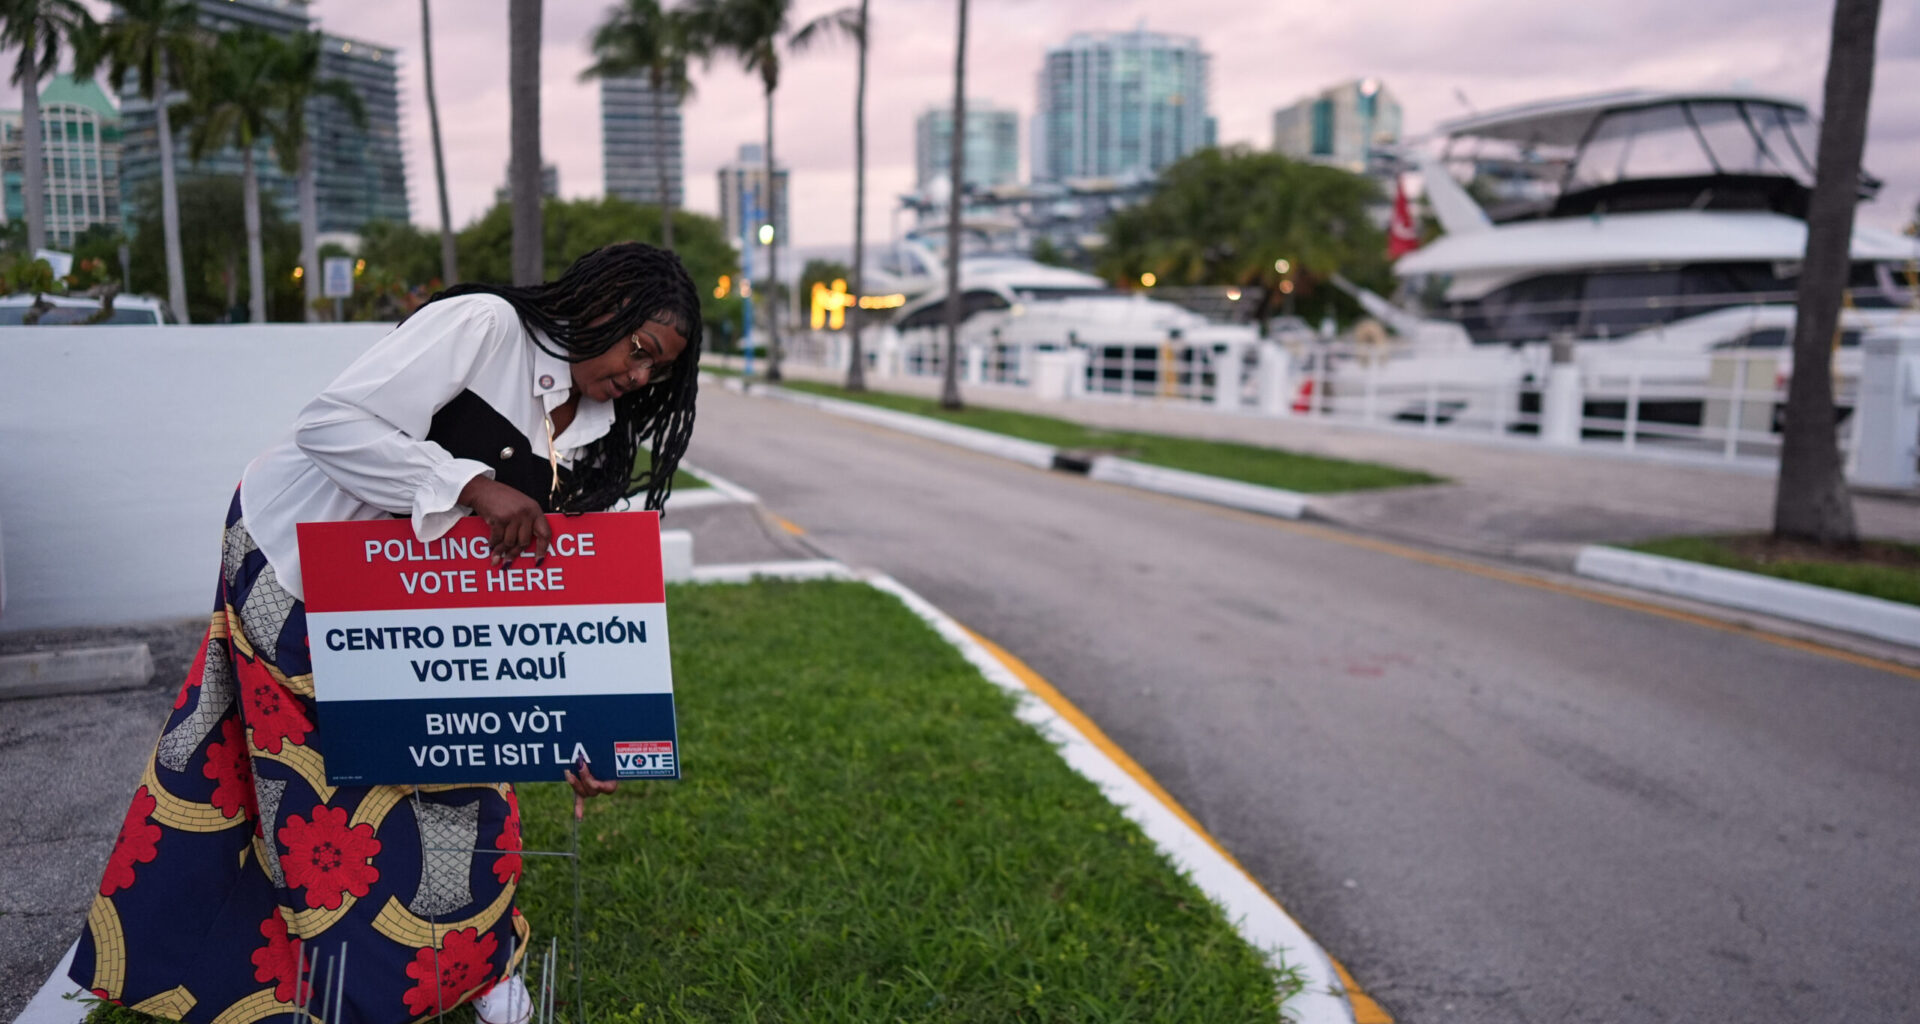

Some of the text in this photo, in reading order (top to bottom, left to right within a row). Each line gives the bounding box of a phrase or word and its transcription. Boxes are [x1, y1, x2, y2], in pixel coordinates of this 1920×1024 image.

[364, 536, 490, 563] POLLING
[400, 567, 565, 595] VOTE HERE
[325, 616, 648, 652] CENTRO DE VOTACIÓN
[410, 651, 566, 682] VOTE AQUÍ
[425, 705, 567, 736] BIWO VÒT
[408, 742, 592, 767] VOTE ISIT LA
[616, 754, 673, 768] VOTE
